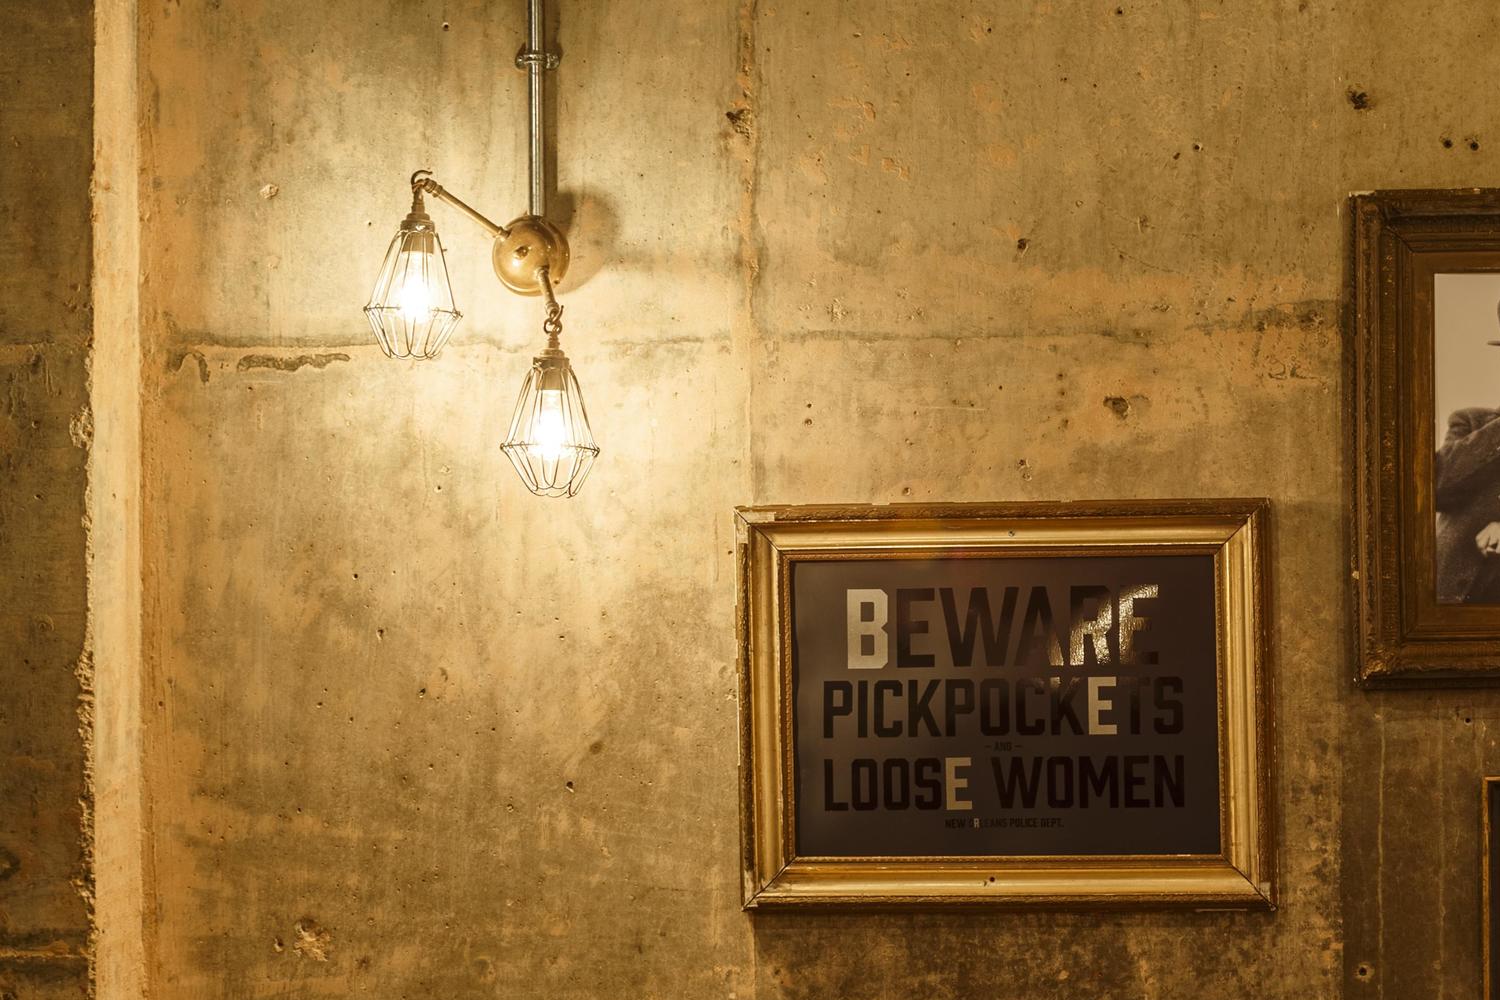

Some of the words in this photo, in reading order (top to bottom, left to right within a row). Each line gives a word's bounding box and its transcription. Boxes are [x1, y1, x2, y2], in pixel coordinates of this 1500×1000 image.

[845, 584, 1160, 670] BEWARE
[823, 676, 1185, 738] PICKPOCKETS
[824, 756, 973, 811] LOOSE
[991, 755, 1186, 809] WOMEN
[944, 818, 966, 829] NEW
[1009, 817, 1038, 828] POLICE
